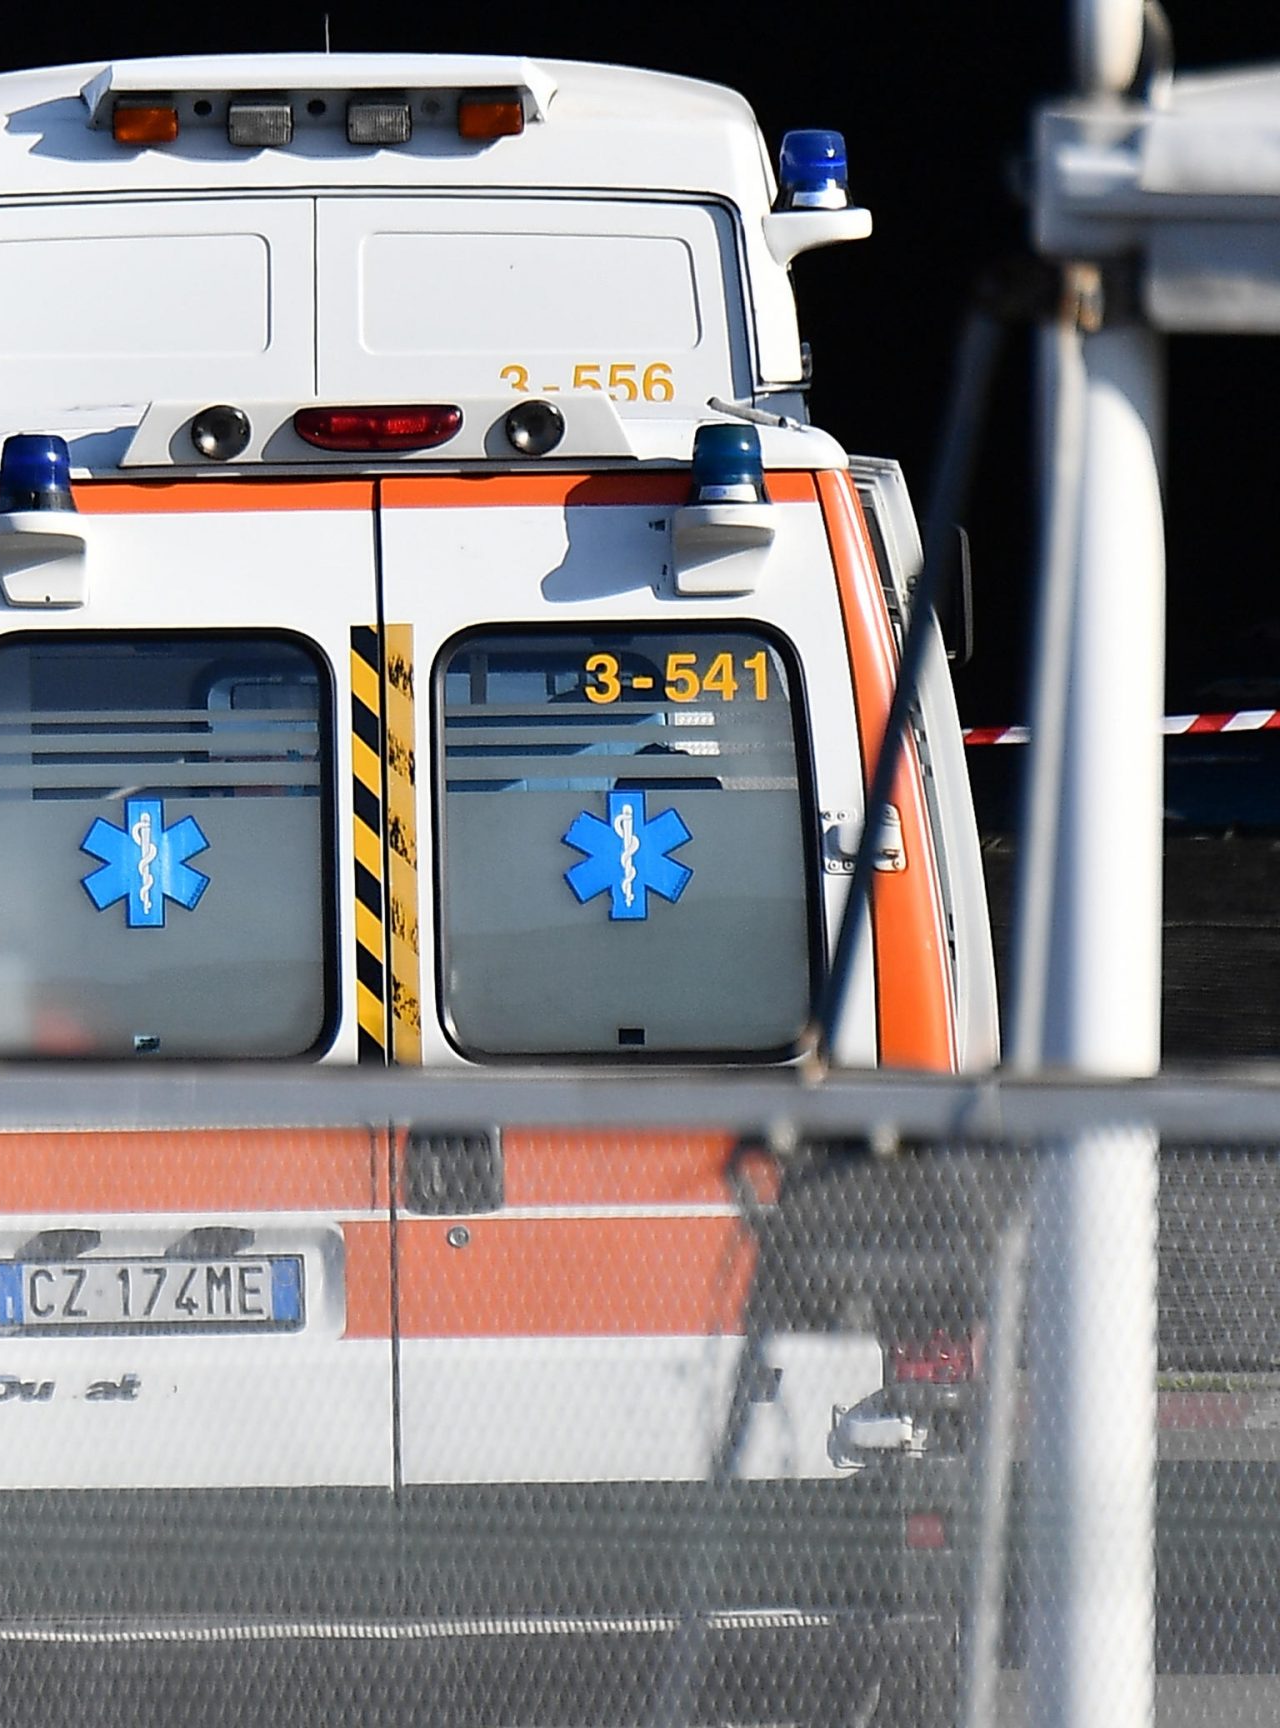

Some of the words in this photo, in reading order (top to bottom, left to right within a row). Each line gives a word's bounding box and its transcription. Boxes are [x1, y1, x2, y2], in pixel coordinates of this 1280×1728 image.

[585, 652, 769, 703] 3-541
[28, 1267, 89, 1318] CZ
[117, 1266, 265, 1317] 174ME
